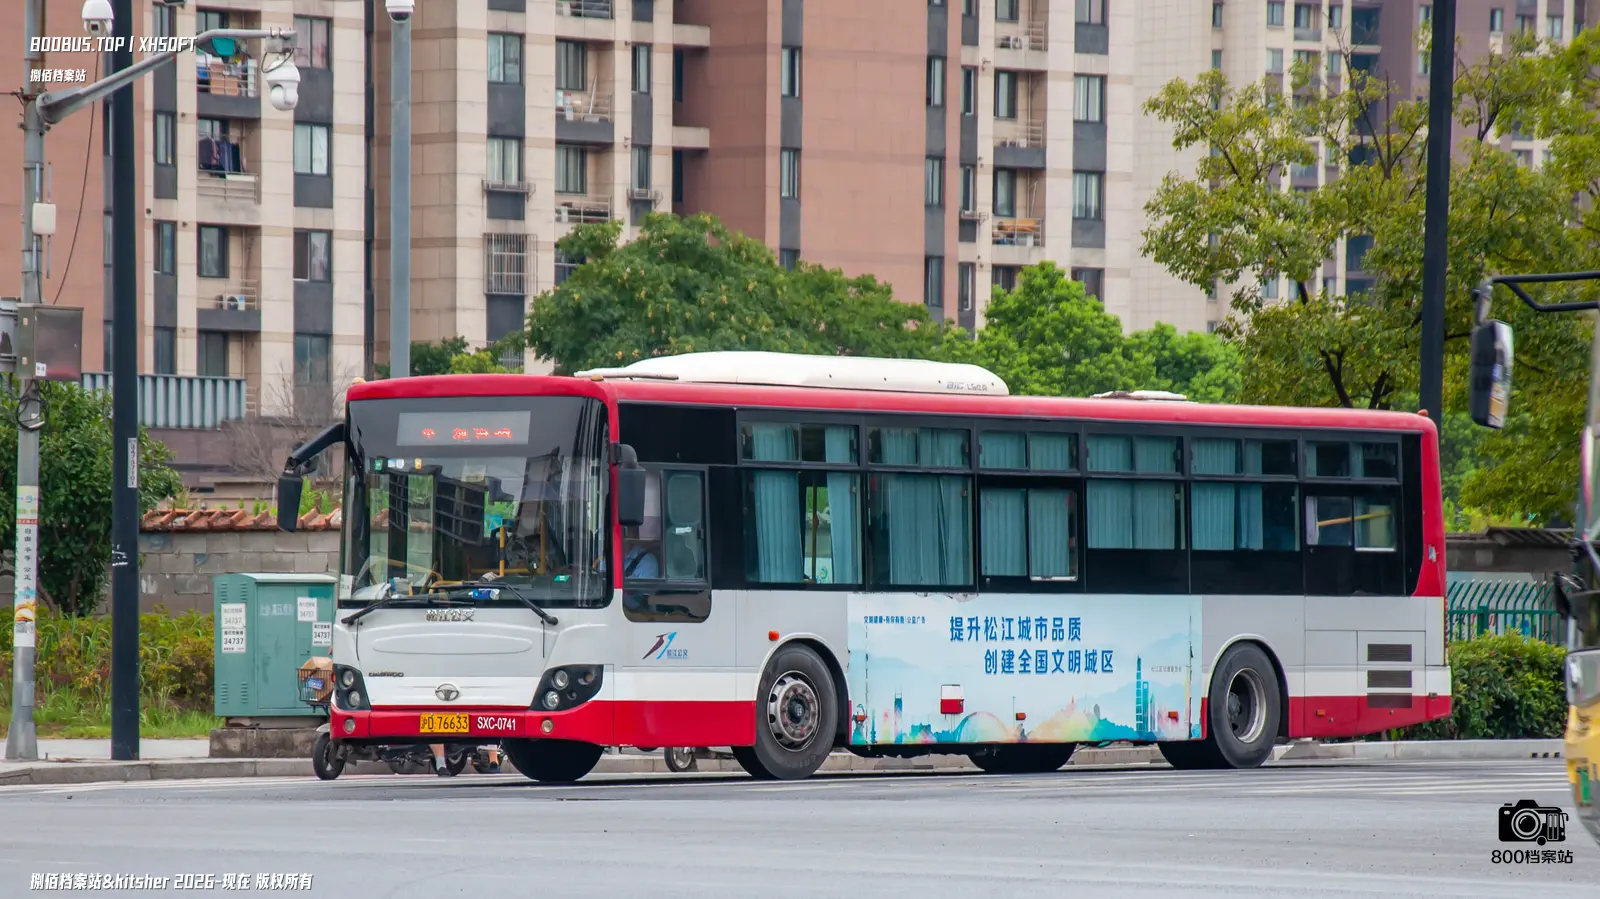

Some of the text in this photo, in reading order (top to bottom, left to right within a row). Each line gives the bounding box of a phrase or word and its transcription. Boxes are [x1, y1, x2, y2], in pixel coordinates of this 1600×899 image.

[314, 631, 331, 639] 34737
[950, 616, 1081, 642] 提升松江城市品质
[224, 637, 244, 645] 34737
[984, 649, 1114, 674] 创建全国文明城区
[477, 716, 516, 730] SXC-0741
